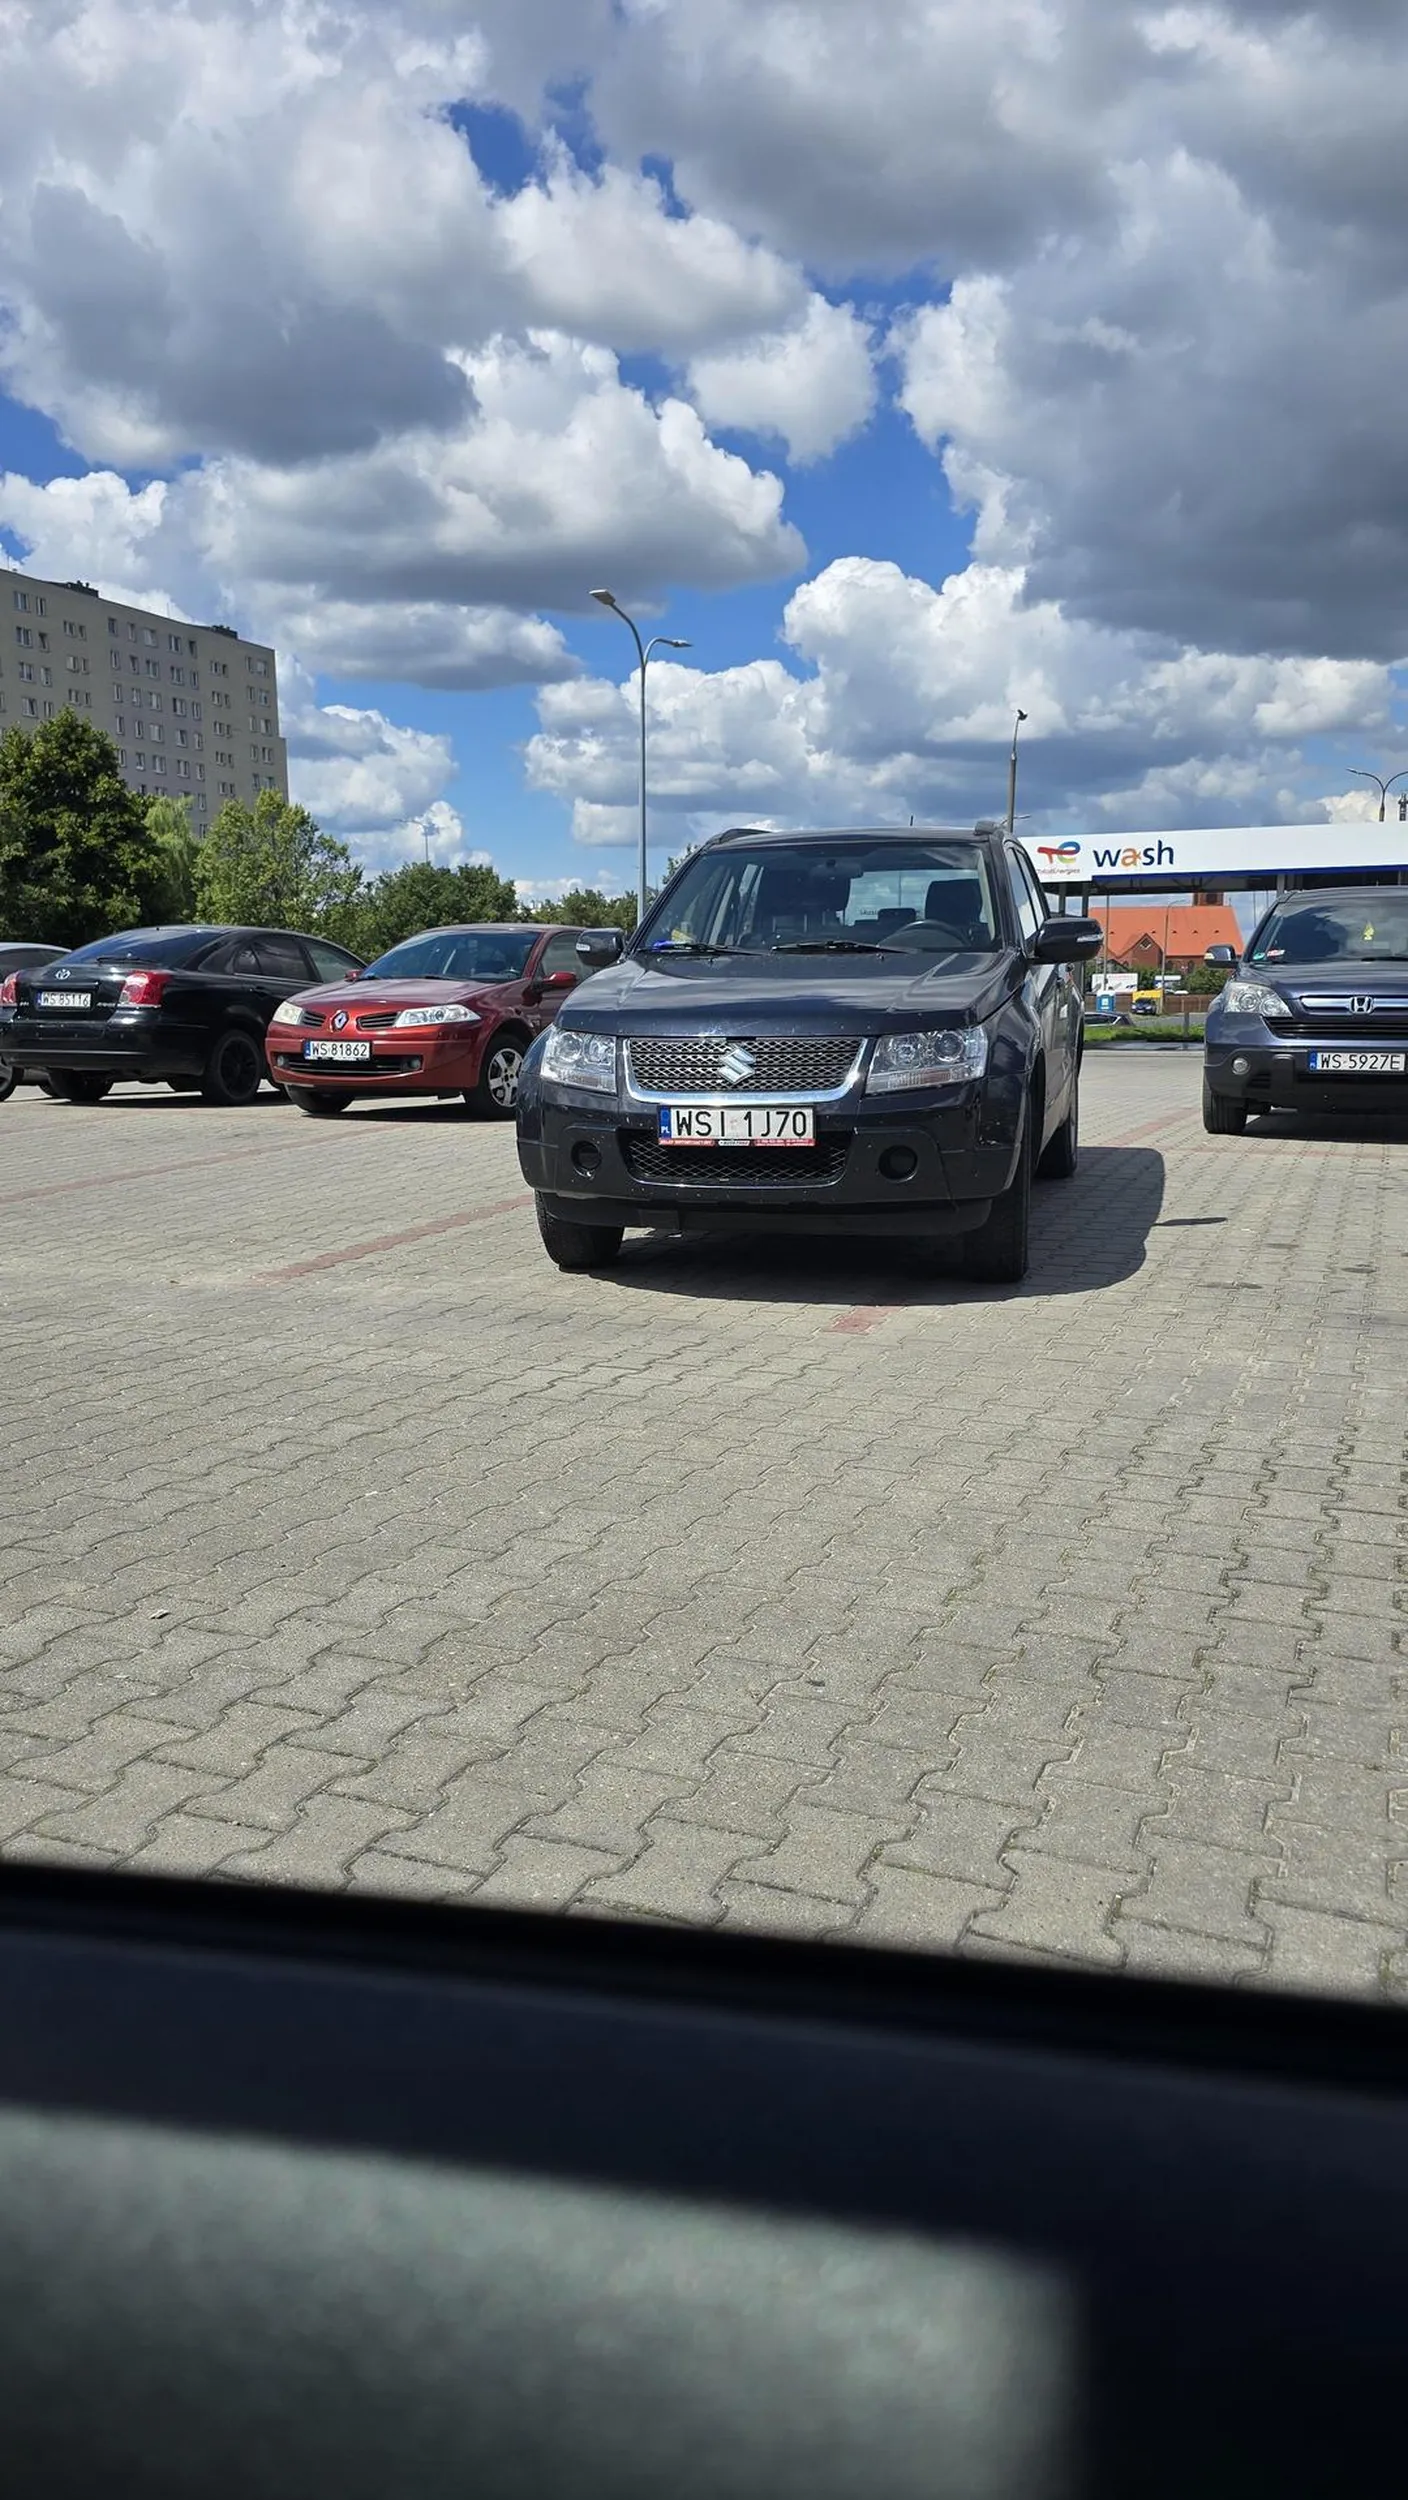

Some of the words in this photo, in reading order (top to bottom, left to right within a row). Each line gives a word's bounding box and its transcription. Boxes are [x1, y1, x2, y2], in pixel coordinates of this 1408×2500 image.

[1092, 839, 1174, 868] wash
[43, 992, 56, 1005] WS
[312, 1042, 328, 1056] WS
[331, 1043, 368, 1057] 81862
[1321, 1053, 1342, 1069] WS
[1348, 1054, 1401, 1070] 5927E
[676, 1110, 725, 1137] WSI
[743, 1111, 807, 1138] 1J70
